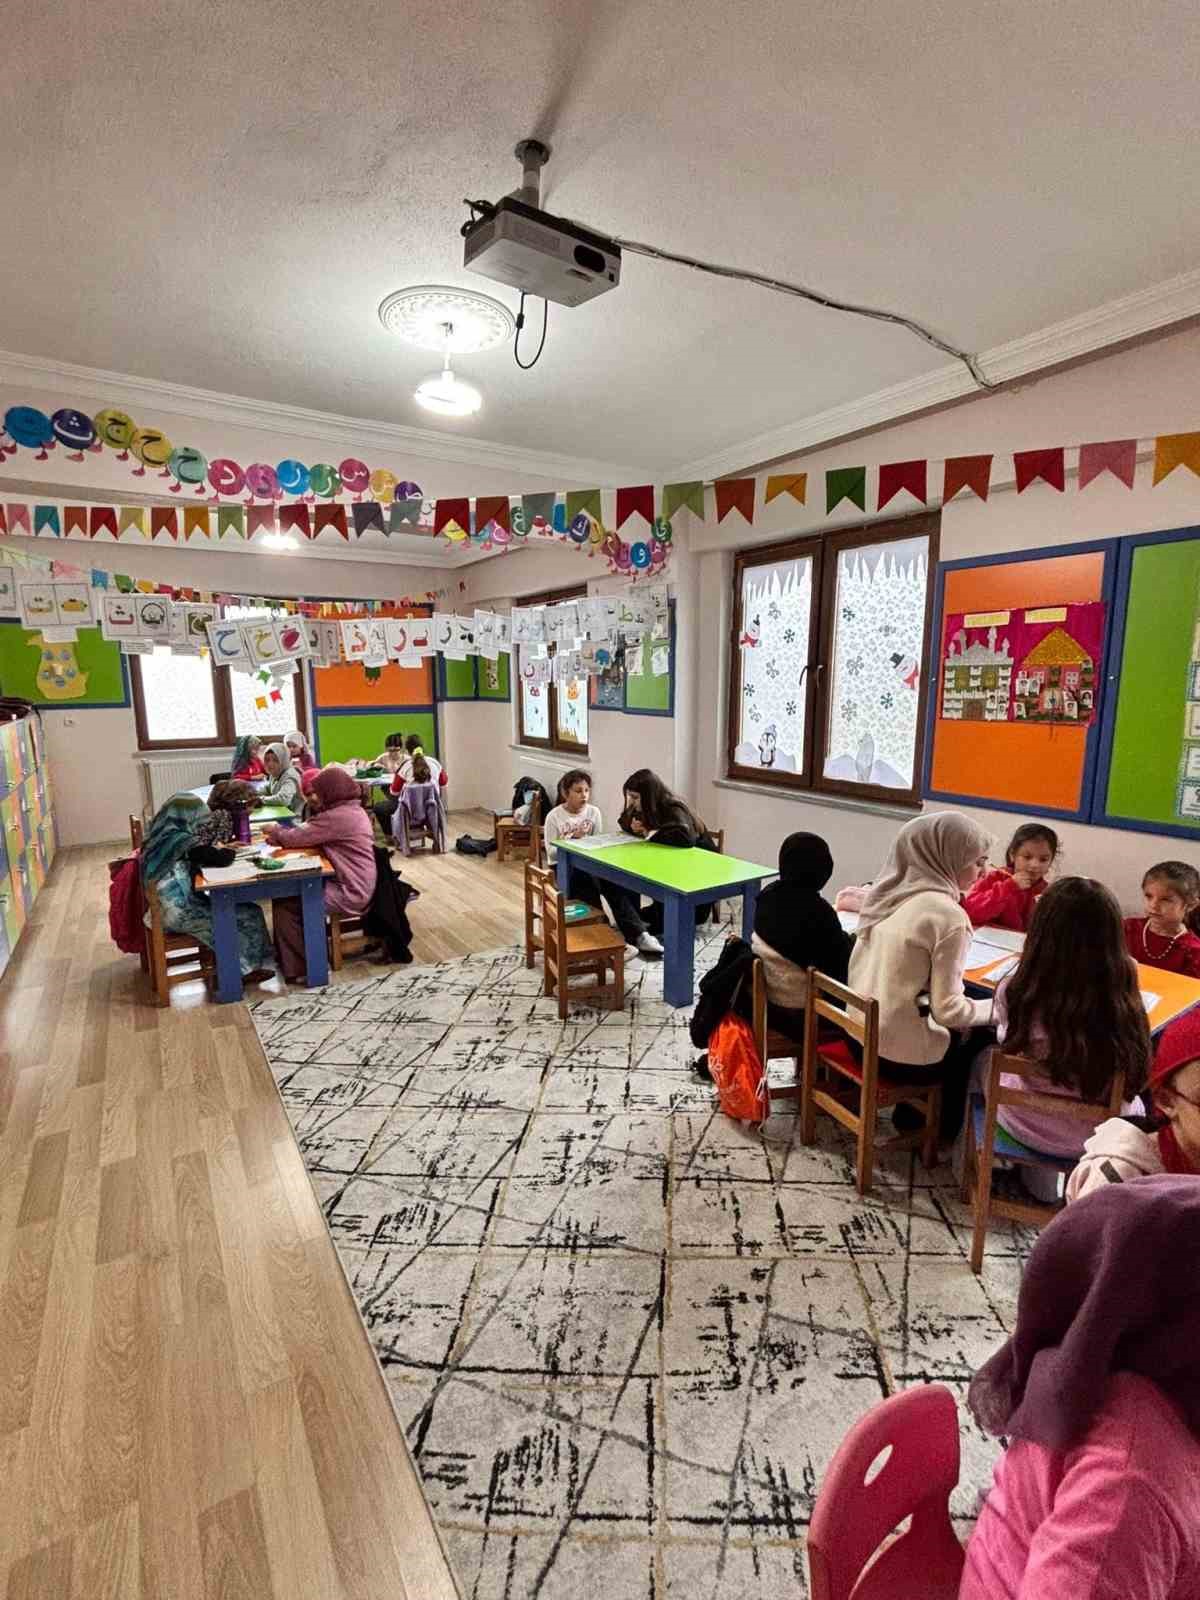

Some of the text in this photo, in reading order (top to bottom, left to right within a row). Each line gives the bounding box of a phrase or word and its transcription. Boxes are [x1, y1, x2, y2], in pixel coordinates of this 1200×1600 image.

[53, 416, 93, 441] ث
[105, 417, 127, 444] ج
[141, 435, 163, 466] ح
[177, 447, 204, 483] خ
[220, 466, 236, 485] د
[341, 469, 366, 482] س
[281, 468, 301, 488] ر
[637, 548, 646, 564] و
[109, 604, 134, 625] ث
[618, 604, 633, 622] ط
[216, 629, 241, 656] ح
[440, 621, 452, 644] ز
